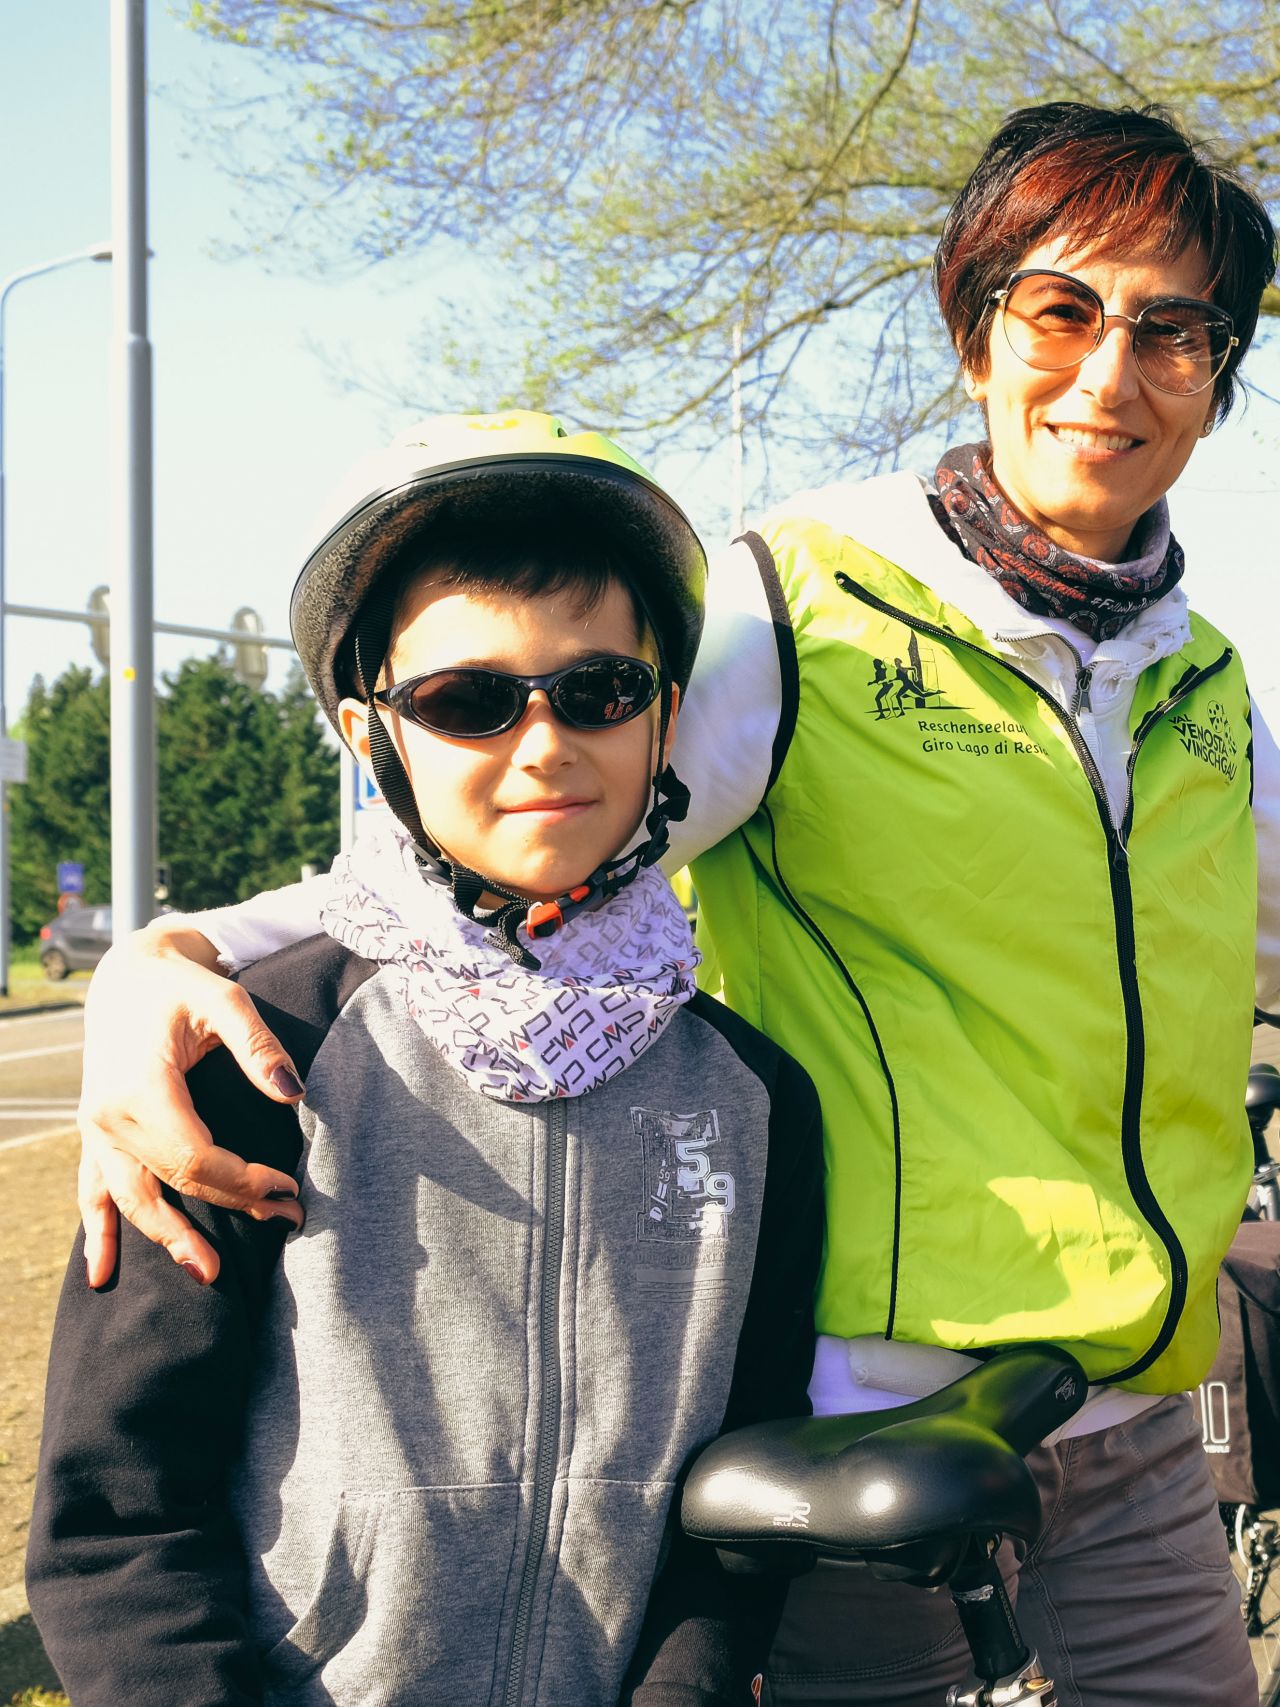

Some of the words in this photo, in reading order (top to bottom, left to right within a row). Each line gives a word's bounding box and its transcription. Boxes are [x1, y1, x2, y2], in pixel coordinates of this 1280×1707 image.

[1168, 713, 1192, 724] VAL
[922, 738, 954, 753] Giro
[957, 741, 989, 756] Lago
[995, 740, 1008, 755] di
[1172, 723, 1229, 758] VENOSTA
[1179, 738, 1238, 781] VINSCHGAU
